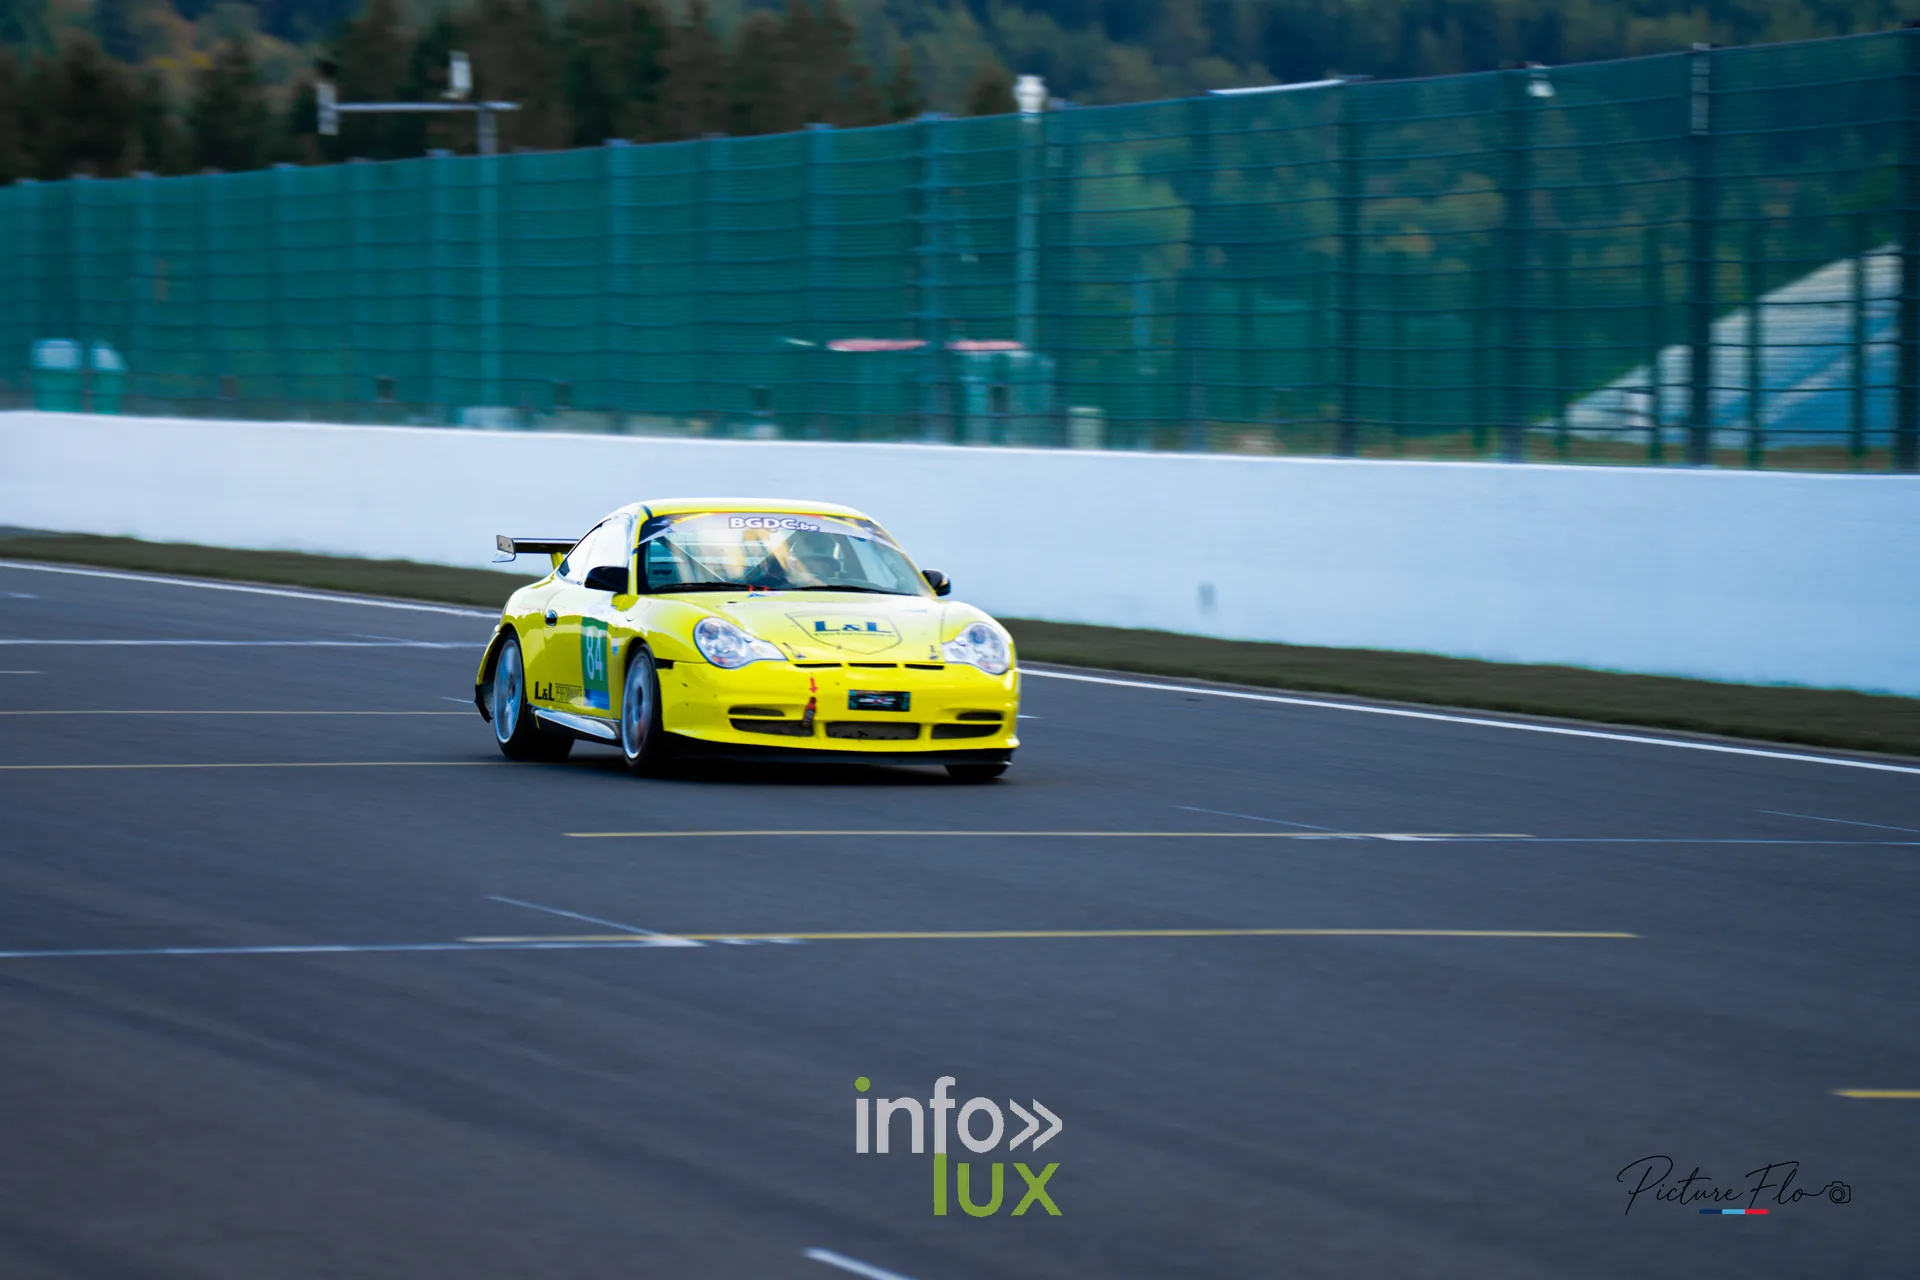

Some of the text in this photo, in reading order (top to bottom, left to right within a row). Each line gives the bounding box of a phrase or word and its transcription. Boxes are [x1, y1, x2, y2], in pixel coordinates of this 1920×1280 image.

[728, 517, 820, 532] BGDC.be
[814, 620, 893, 633] L&L
[585, 626, 603, 681] 84
[534, 681, 555, 701] L&L
